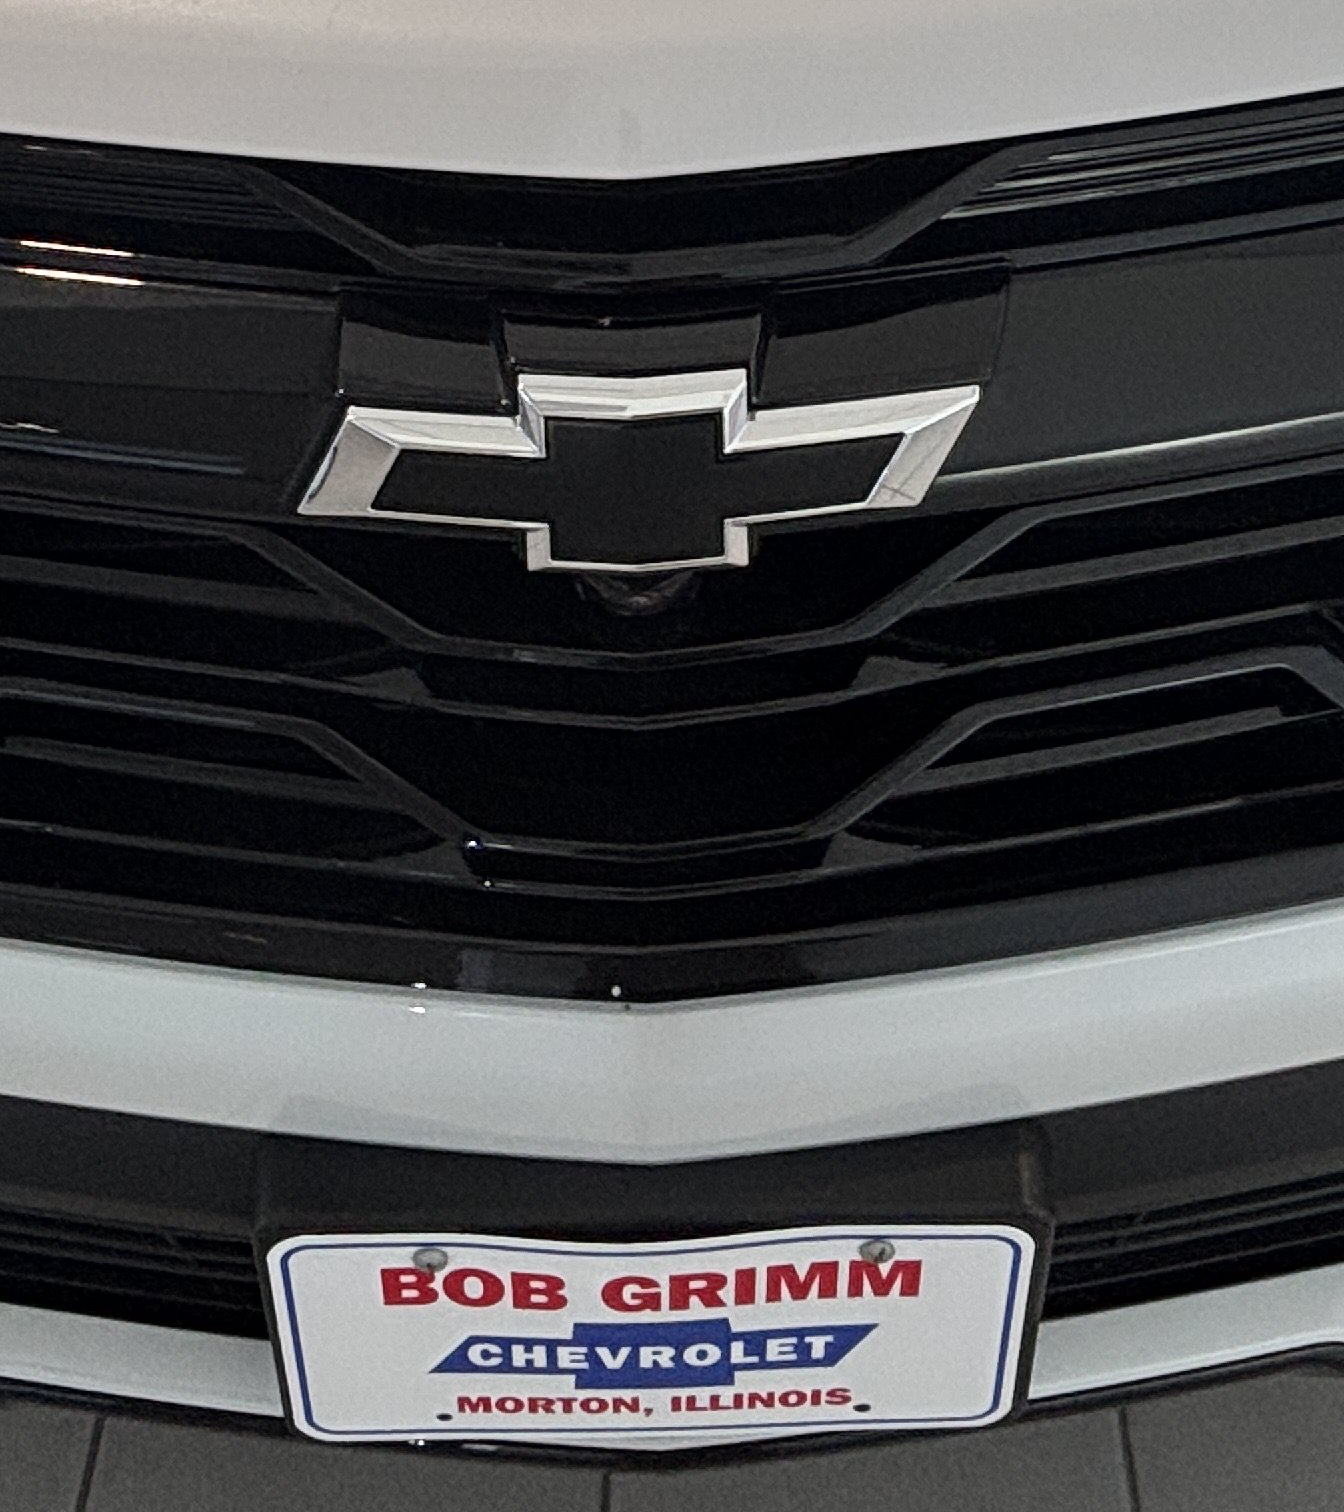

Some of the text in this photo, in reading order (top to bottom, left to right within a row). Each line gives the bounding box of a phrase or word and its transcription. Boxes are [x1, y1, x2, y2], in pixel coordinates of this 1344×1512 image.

[380, 1259, 922, 1312] BOB GRIMM
[467, 1335, 834, 1368] CHEVROLET
[457, 1388, 852, 1417] MORTON, ILLINOIS
